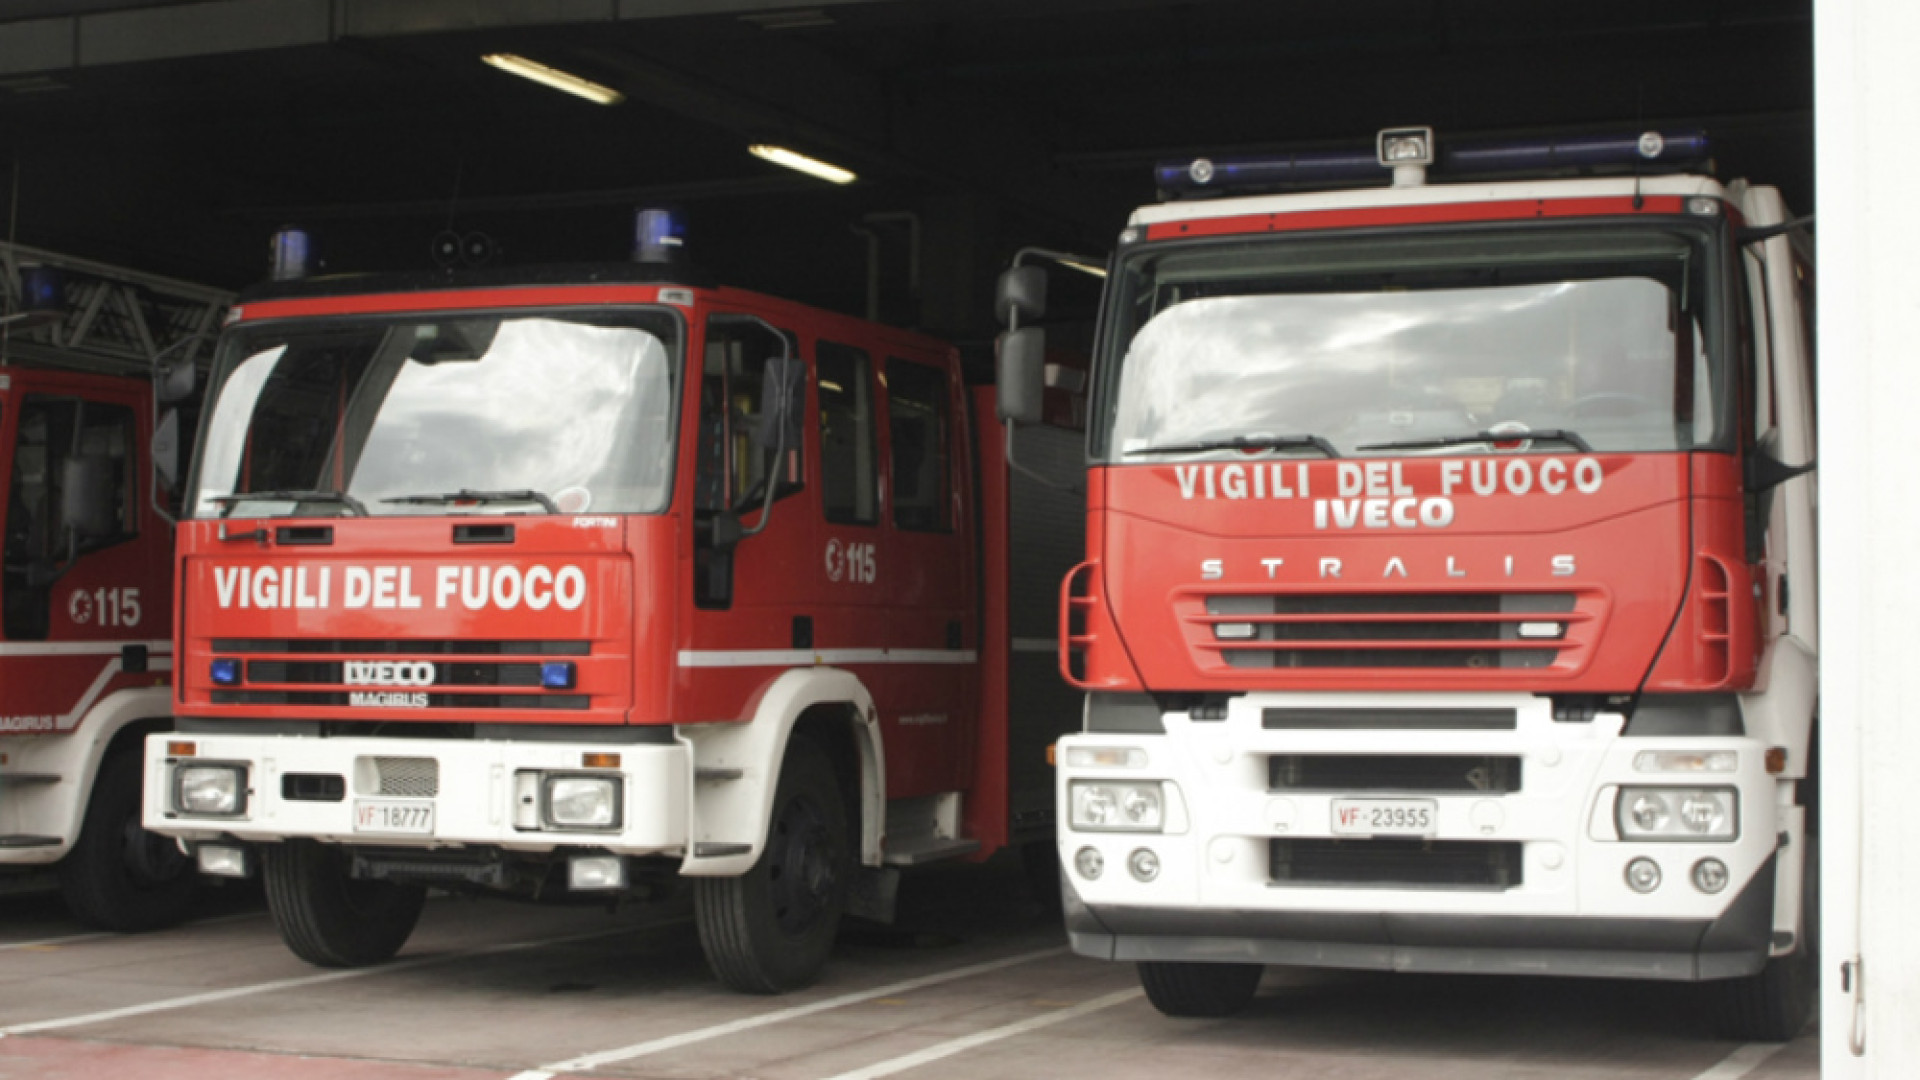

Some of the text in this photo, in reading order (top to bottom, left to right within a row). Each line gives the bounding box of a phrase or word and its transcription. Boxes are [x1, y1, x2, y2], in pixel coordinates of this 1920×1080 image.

[1175, 457, 1602, 499] VIGILI DEL FUOCO
[1314, 497, 1454, 529] IVECO
[847, 542, 876, 584] 115
[1200, 554, 1576, 579] STRALIS
[214, 564, 586, 610] VIGILI DEL FUOCO
[94, 587, 141, 627] 115
[343, 660, 436, 685] IVECO
[349, 692, 428, 707] MAGIRUS
[358, 806, 430, 827] VF 18777
[1371, 807, 1429, 827] 23955
